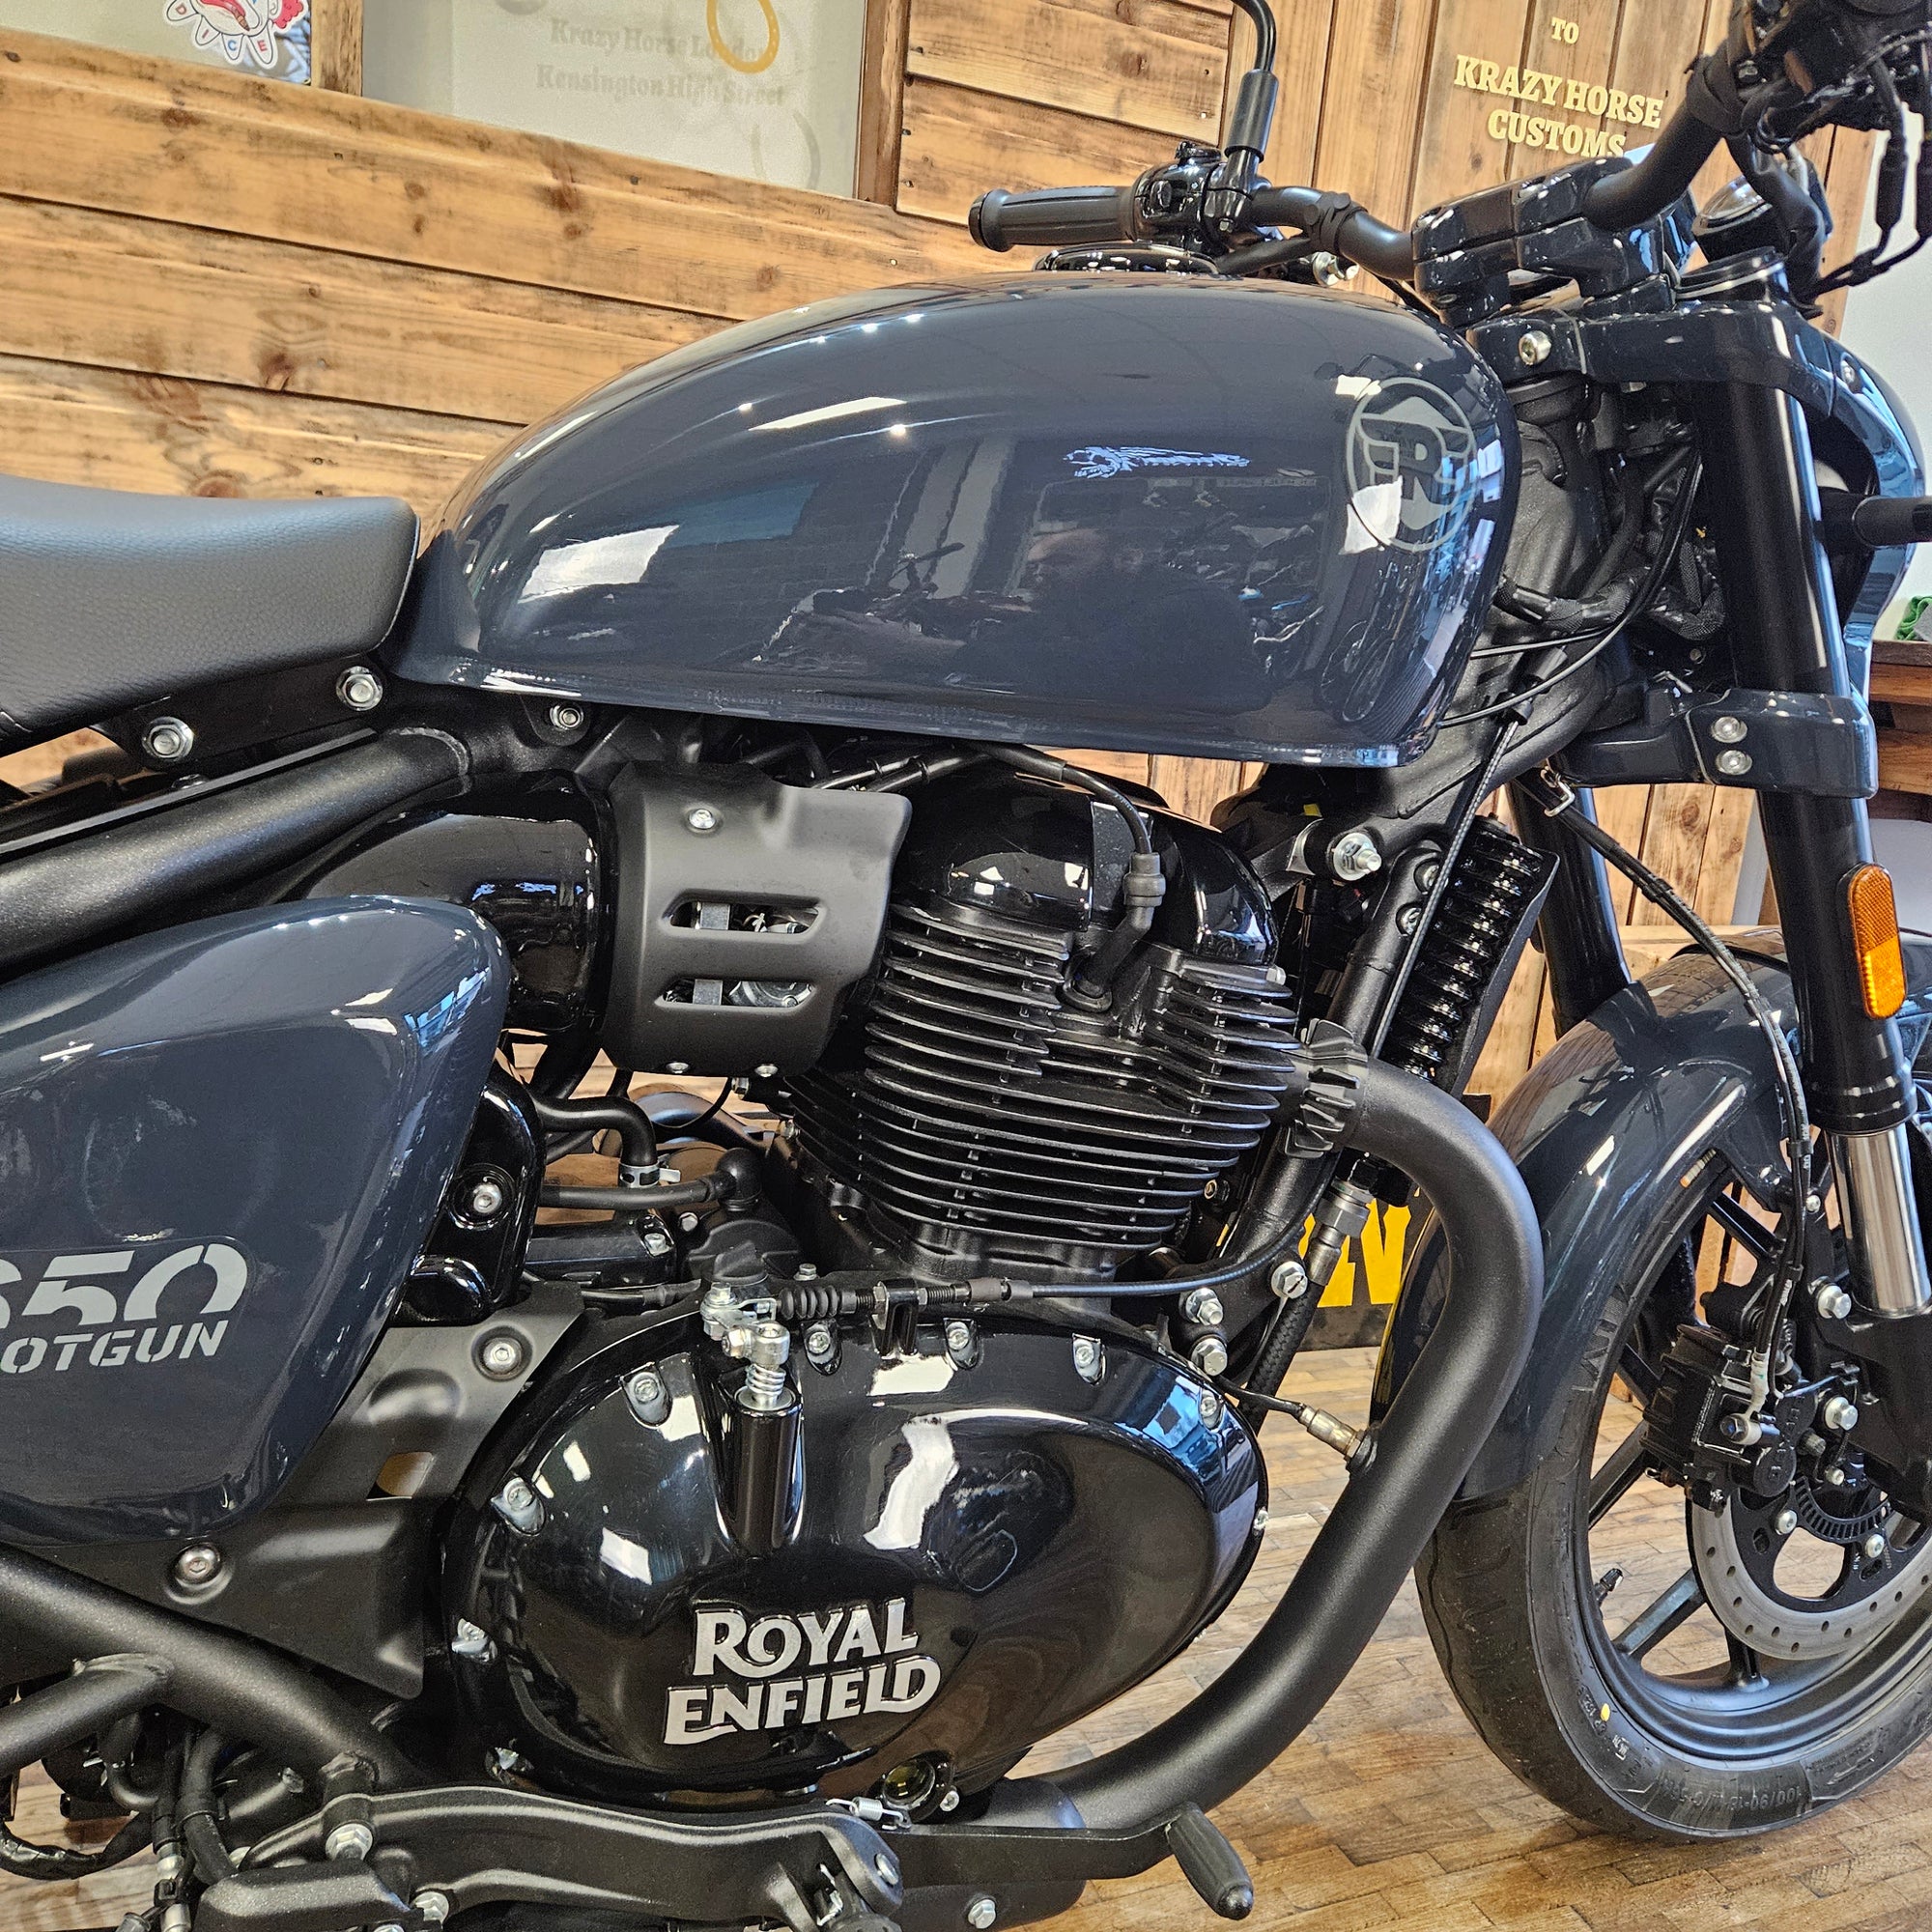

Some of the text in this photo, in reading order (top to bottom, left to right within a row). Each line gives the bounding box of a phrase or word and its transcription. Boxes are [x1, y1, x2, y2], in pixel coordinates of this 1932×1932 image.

[551, 17, 619, 56] Krazy
[624, 26, 688, 55] Horse
[1551, 16, 1579, 44] TO
[535, 63, 667, 102] Kensington
[1453, 53, 1664, 129] KRAZY HORSE
[1487, 108, 1627, 158] CUSTOMS
[692, 1596, 919, 1679] ROYAL
[663, 1654, 942, 1746] ENFIELD
